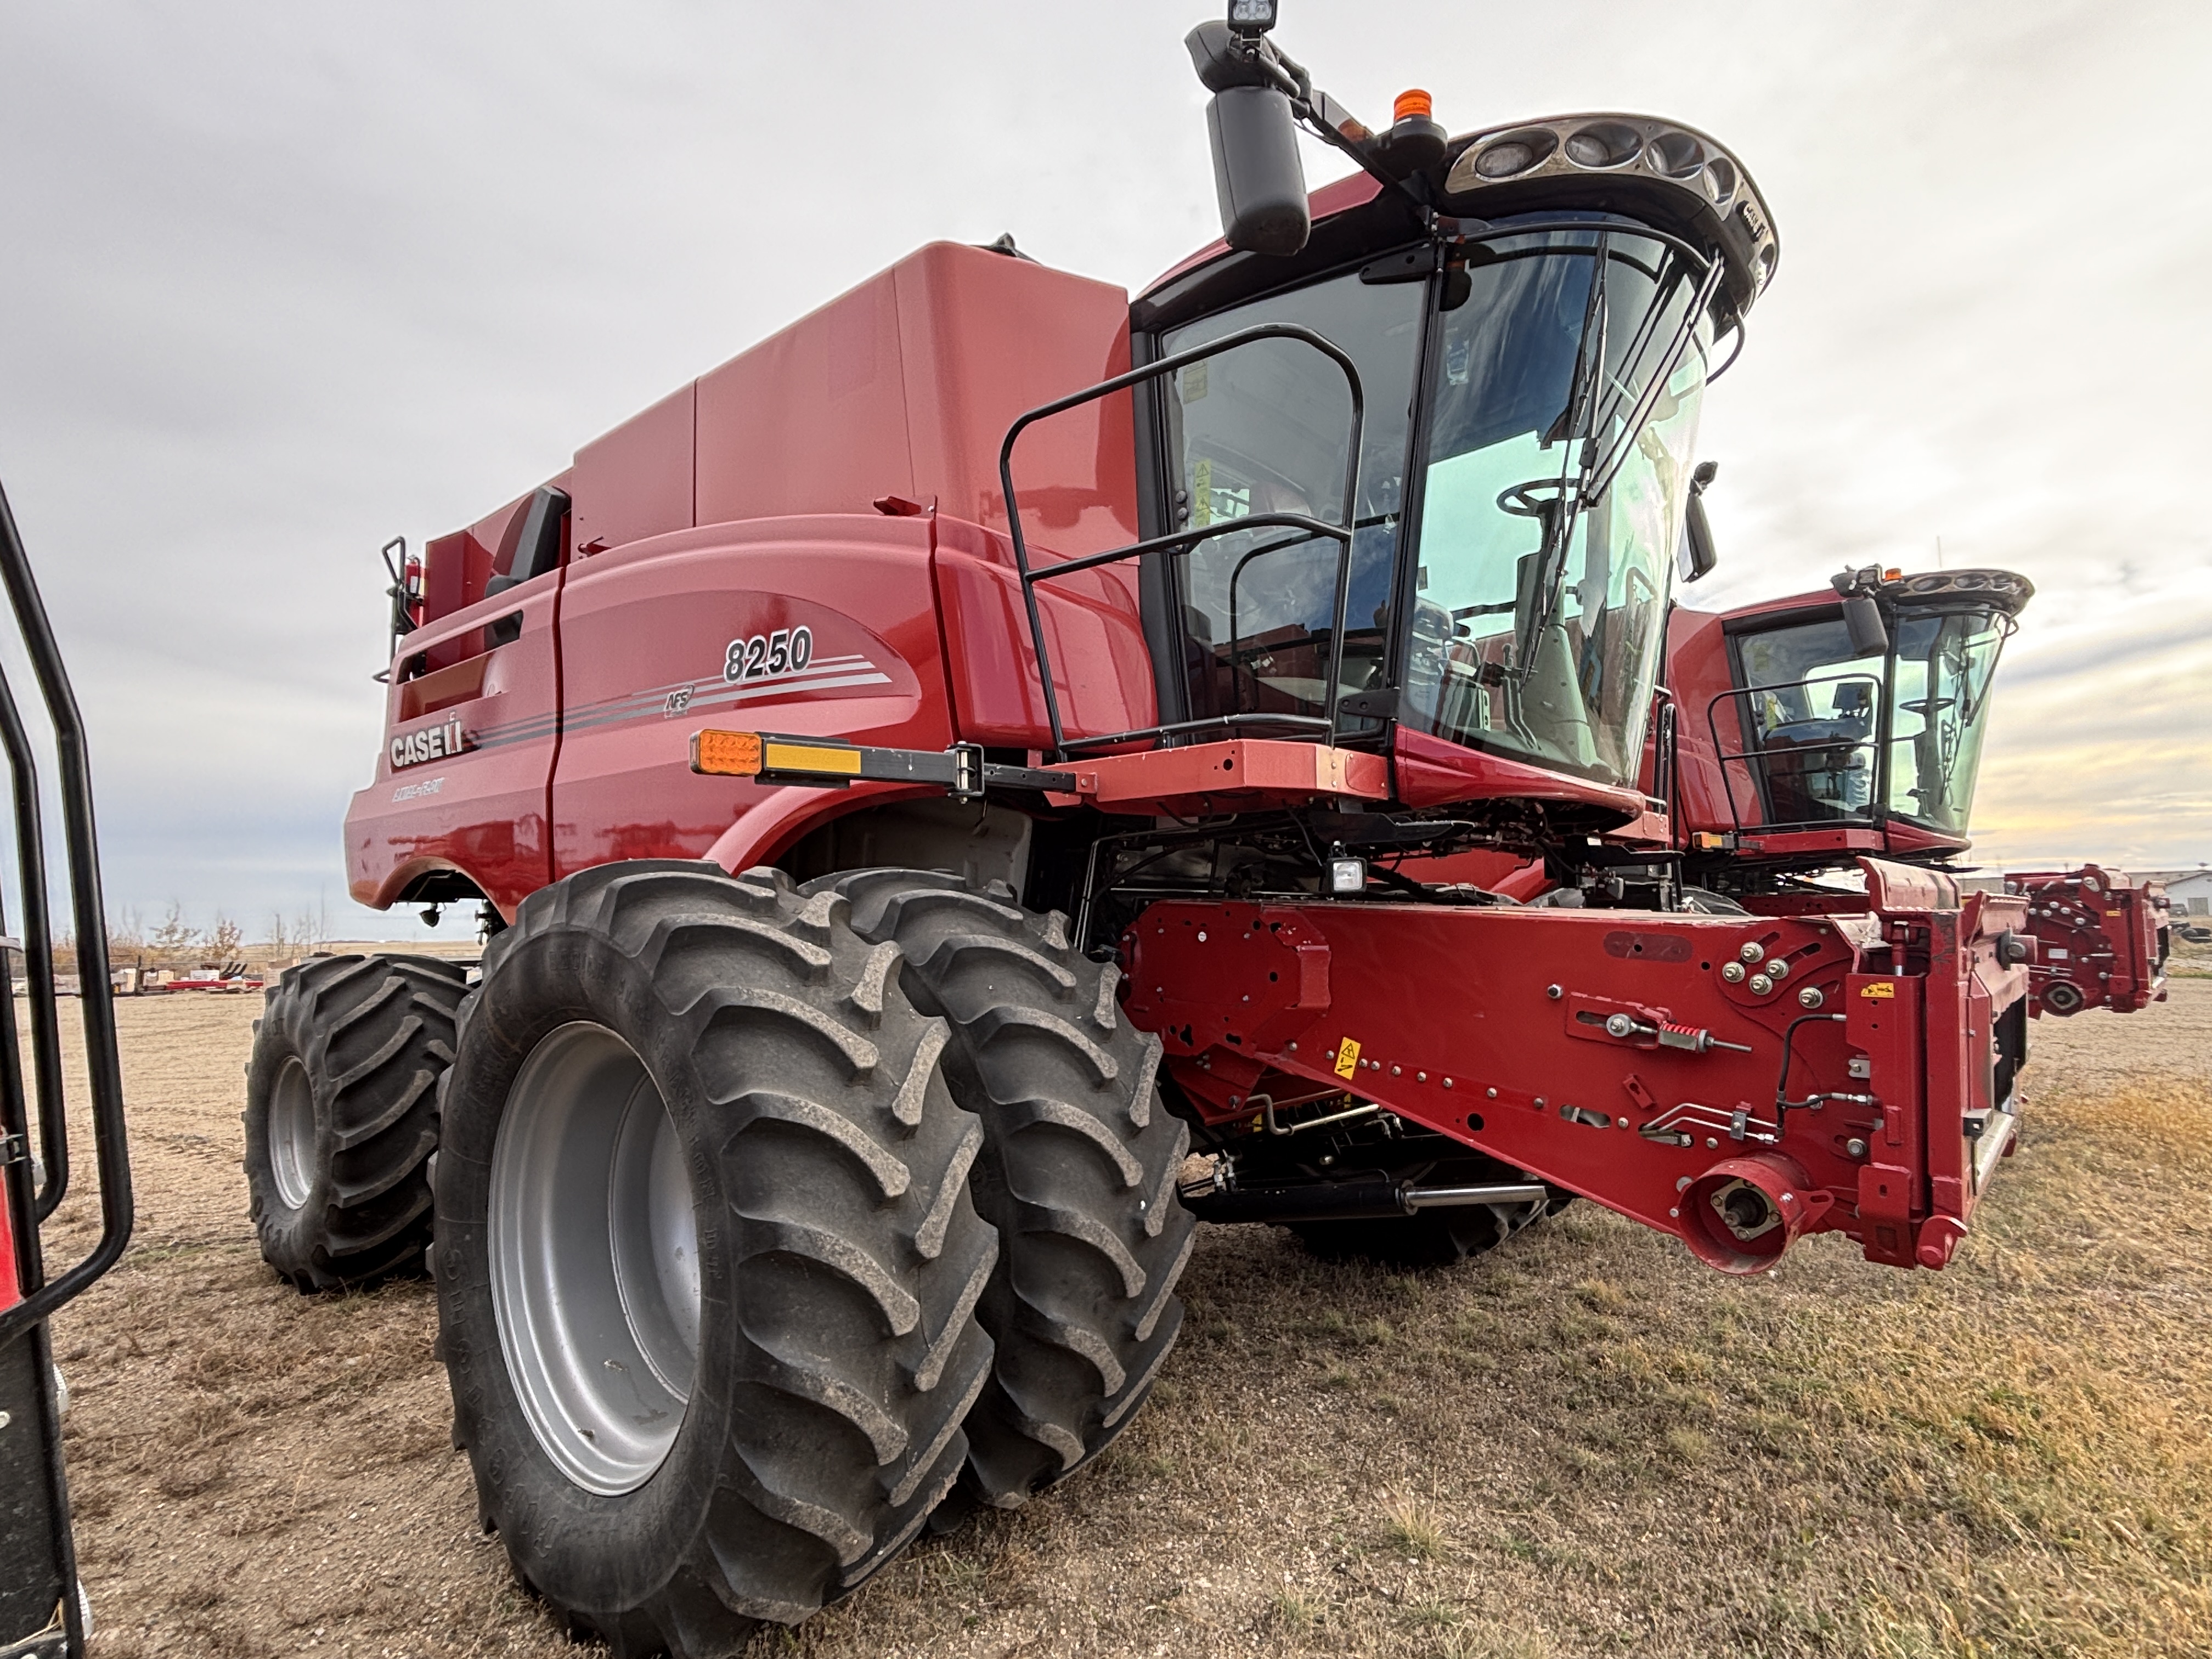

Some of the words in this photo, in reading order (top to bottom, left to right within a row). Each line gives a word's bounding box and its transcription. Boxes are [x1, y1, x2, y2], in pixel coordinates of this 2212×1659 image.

[724, 625, 812, 684] 8250
[664, 690, 688, 709] AFS
[391, 727, 443, 768] CASE
